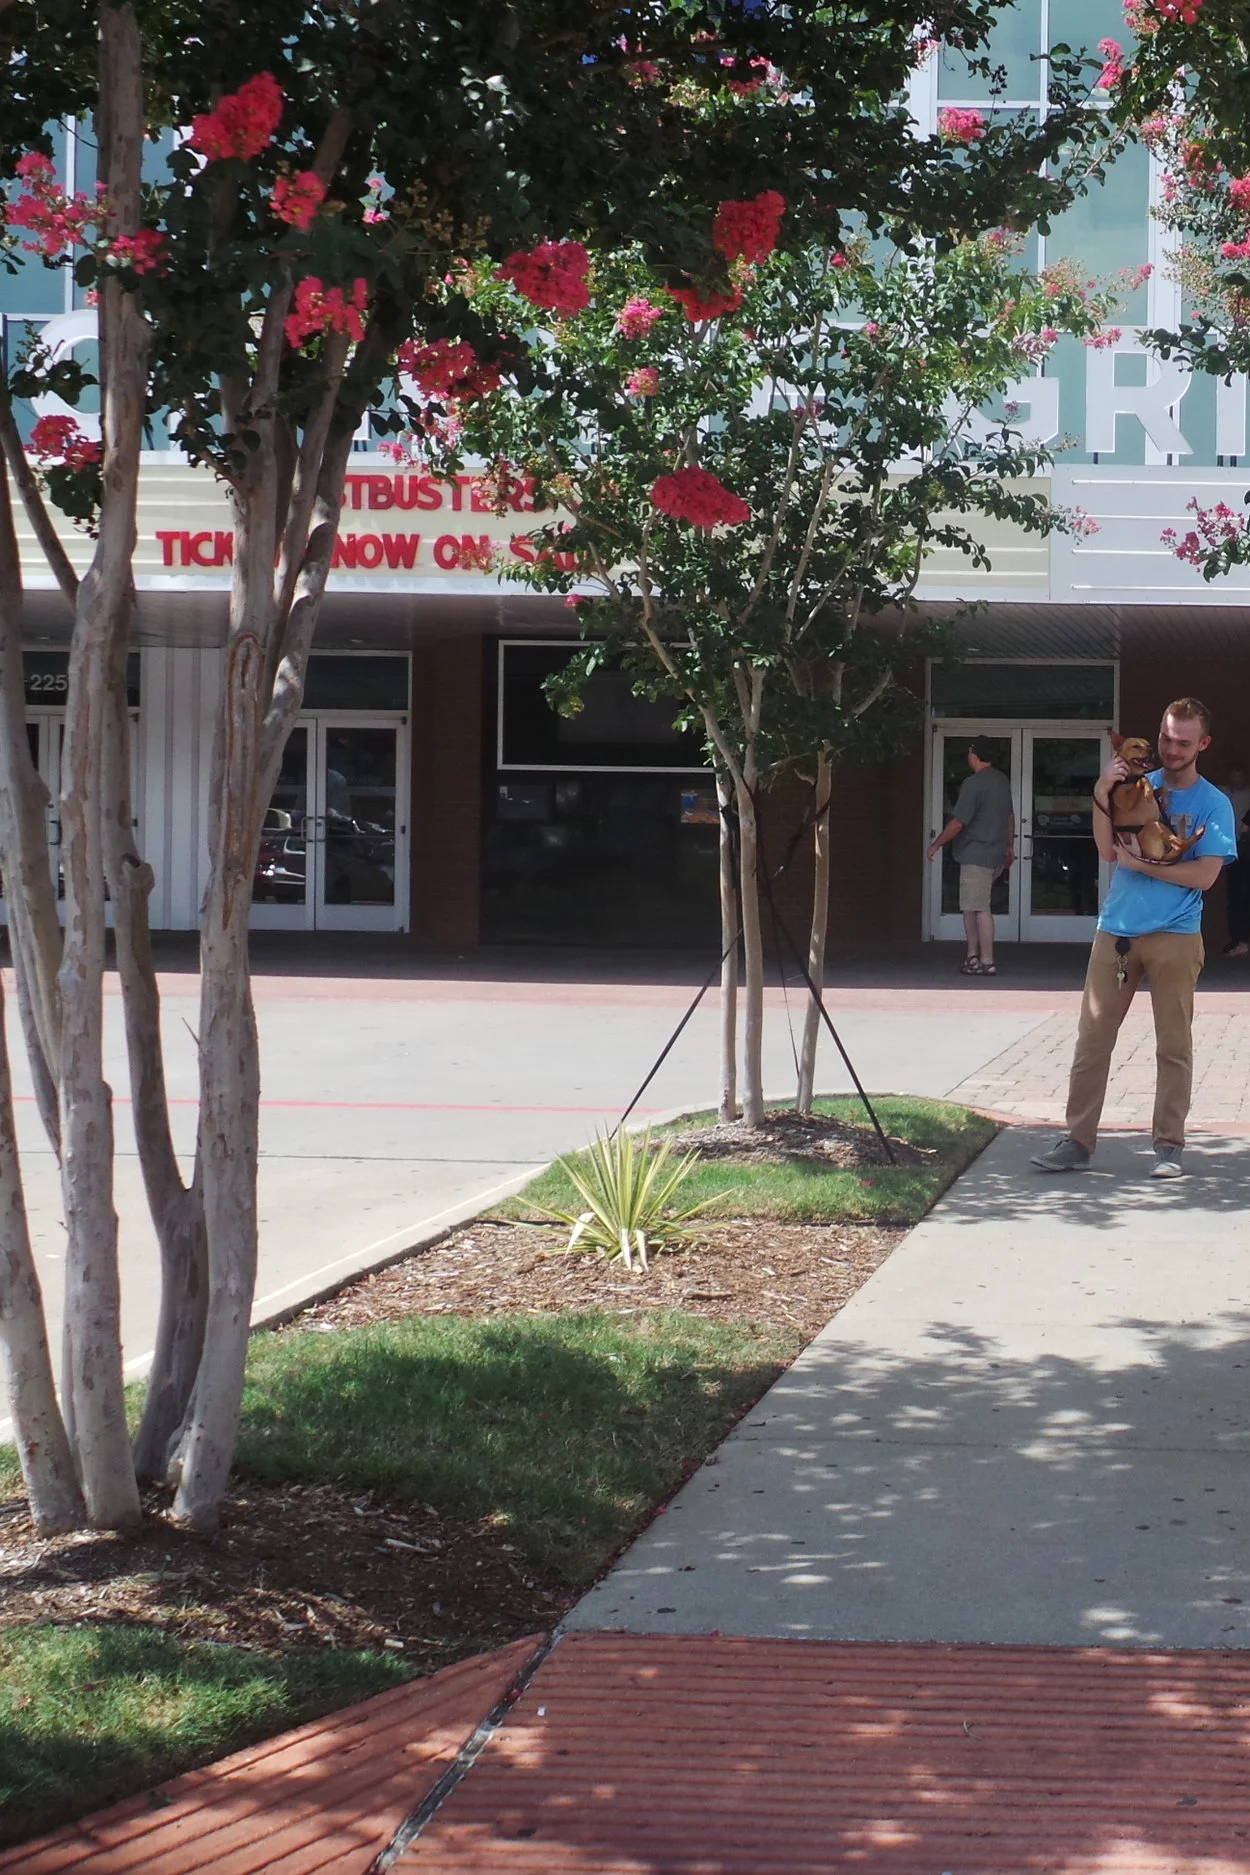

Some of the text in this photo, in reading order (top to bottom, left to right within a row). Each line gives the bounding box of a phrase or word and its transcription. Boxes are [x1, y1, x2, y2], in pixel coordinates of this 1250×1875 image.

[340, 474, 555, 513] TBUSTERS
[329, 533, 421, 569] NOW
[433, 534, 493, 570] ON
